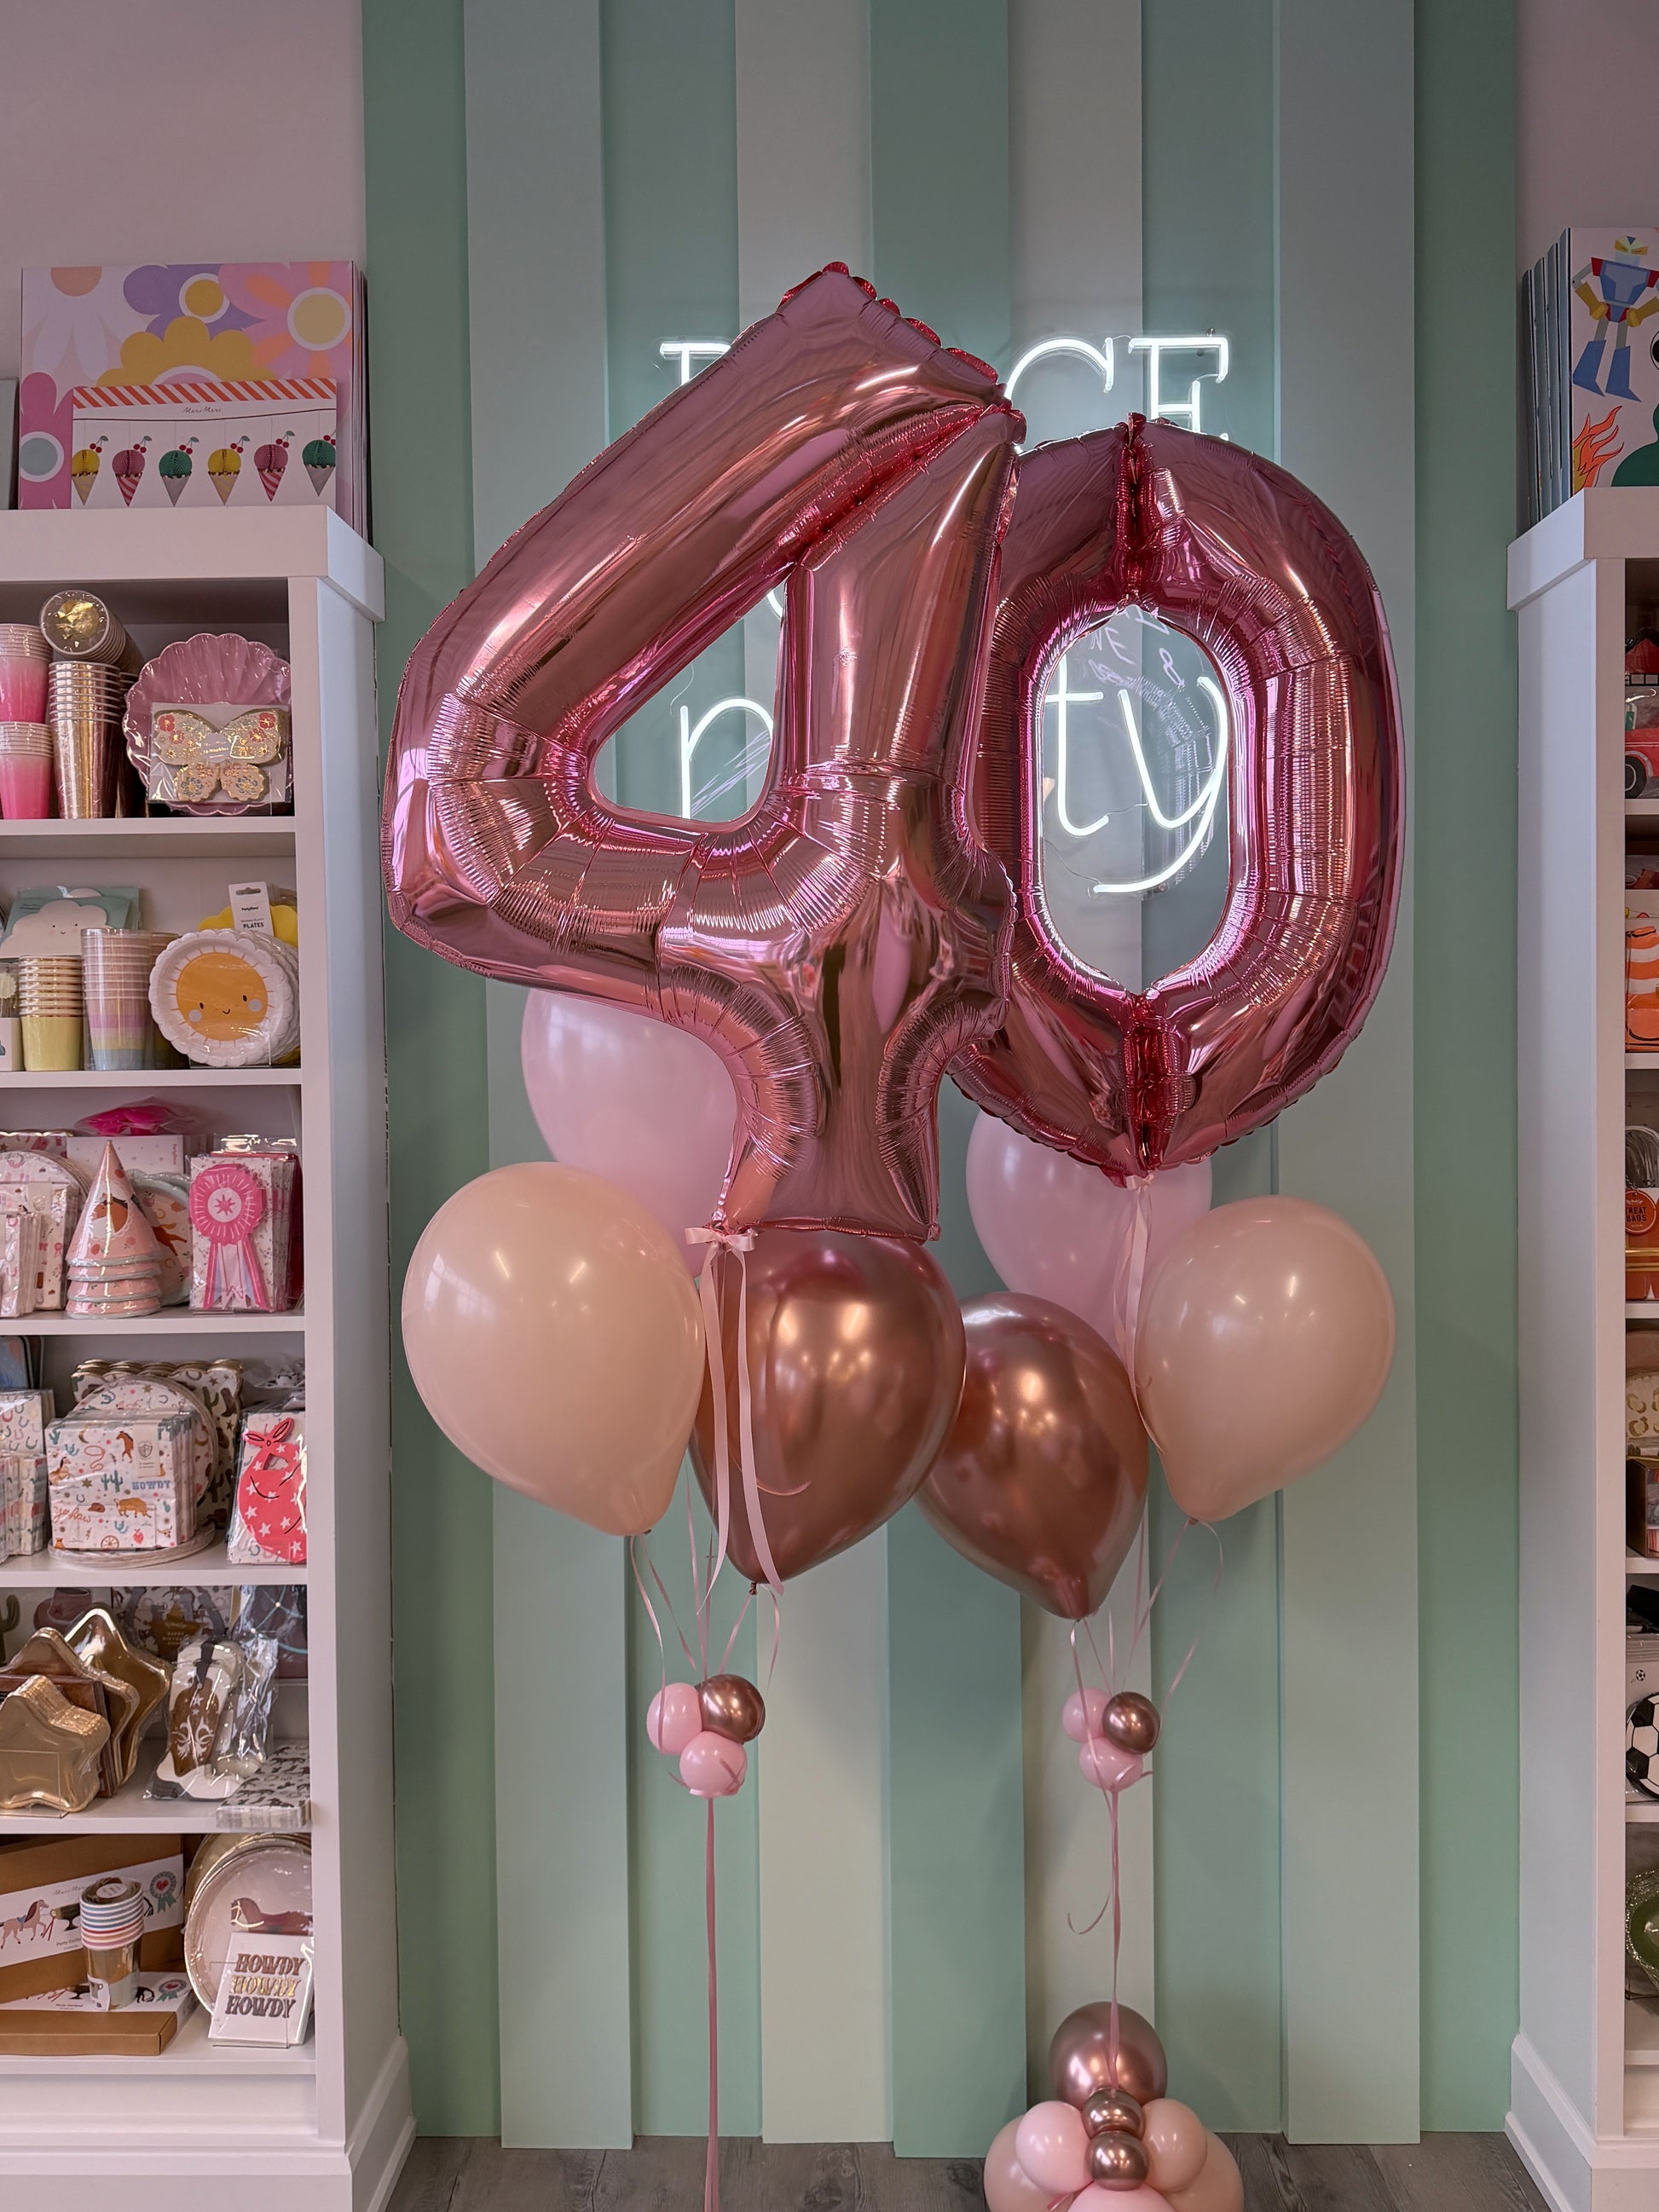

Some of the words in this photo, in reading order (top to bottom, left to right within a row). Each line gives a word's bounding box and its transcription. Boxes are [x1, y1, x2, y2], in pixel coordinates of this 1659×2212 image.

[131, 1480, 171, 1490] HOWDY
[234, 1954, 306, 1977] HOWDY
[229, 1975, 302, 1997] HOWDY
[225, 1995, 297, 2019] HOWDY
